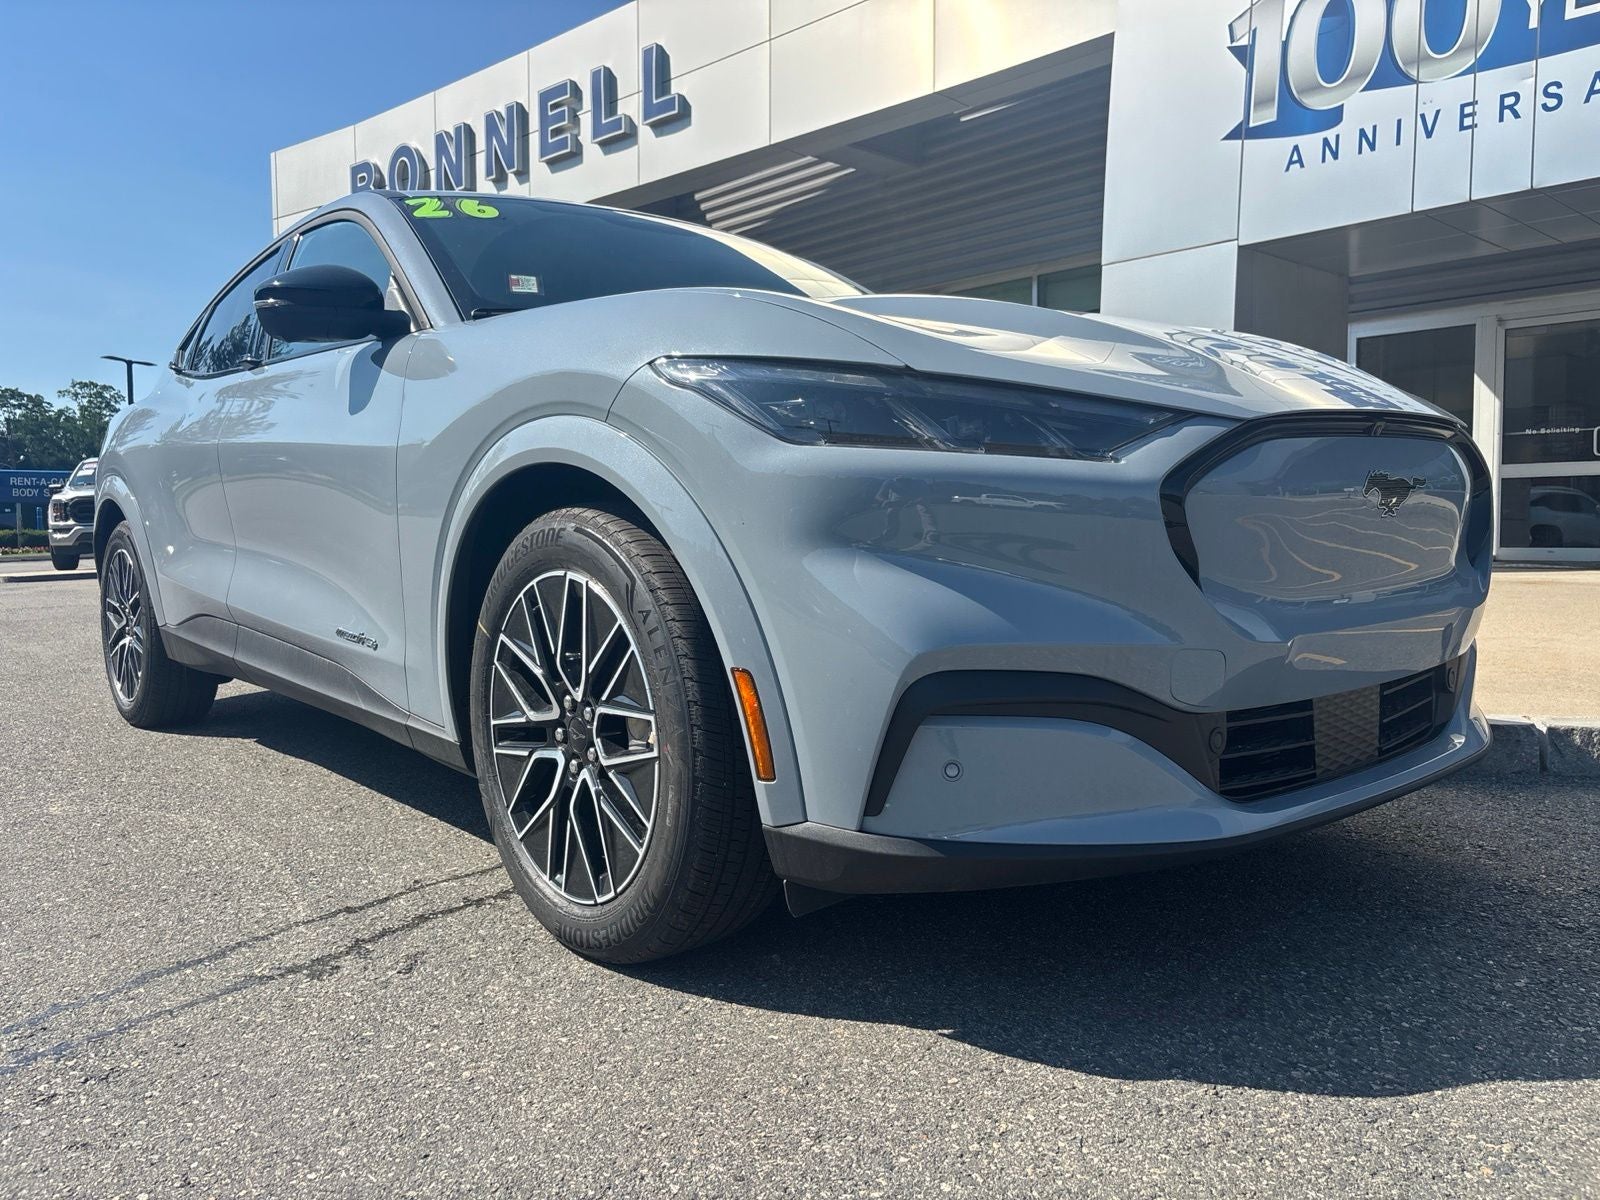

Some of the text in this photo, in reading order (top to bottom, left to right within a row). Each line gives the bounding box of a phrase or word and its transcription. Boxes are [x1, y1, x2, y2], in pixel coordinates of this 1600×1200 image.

[1227, 0, 1501, 128] 100
[350, 42, 685, 193] BONNELL
[405, 196, 500, 219] 26
[1540, 426, 1580, 434] Soliciting
[13, 488, 39, 497] BODY
